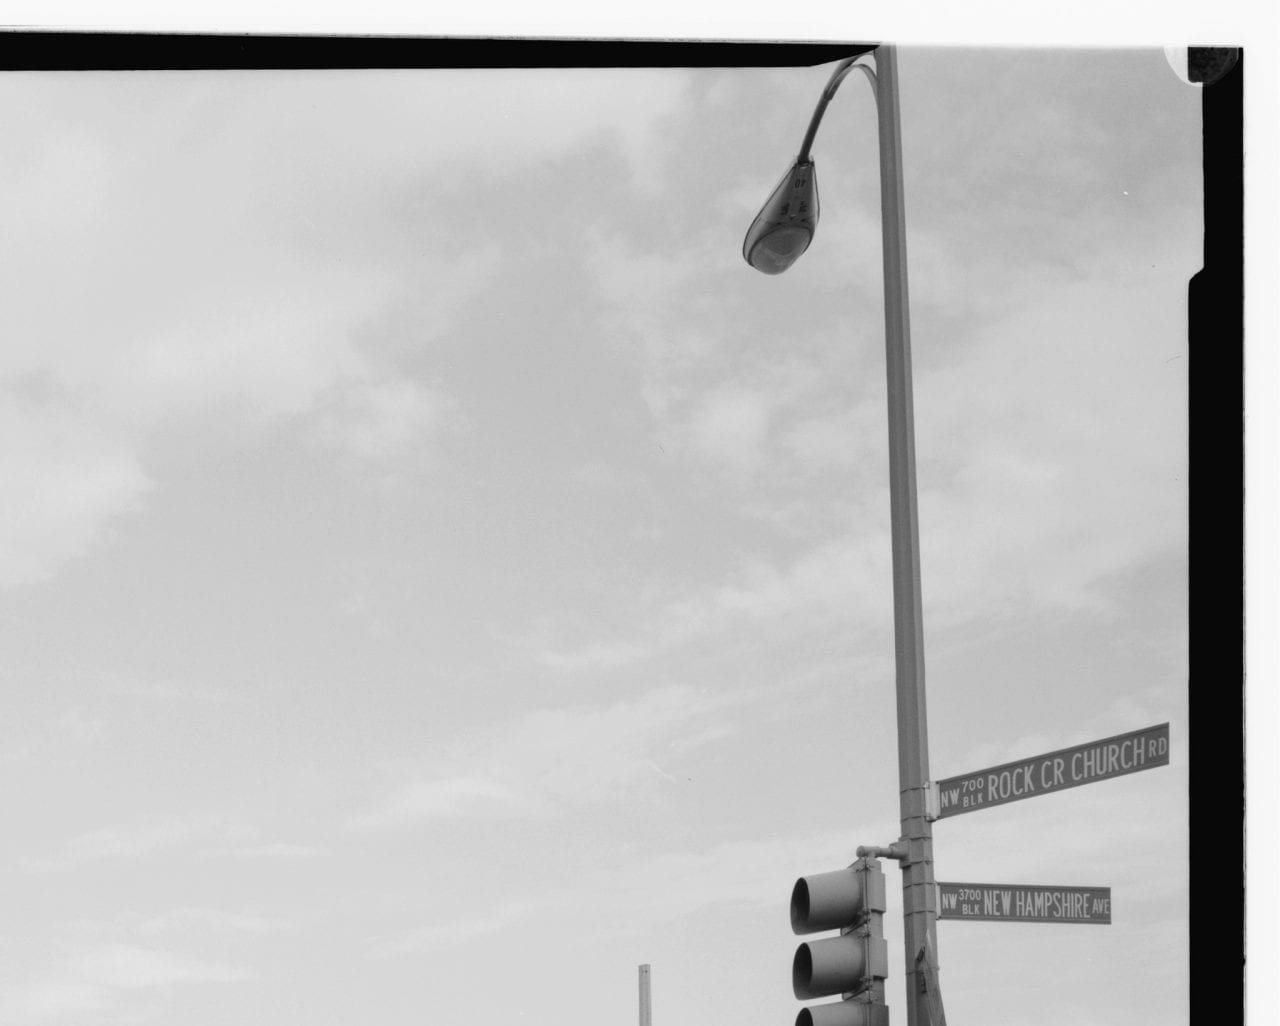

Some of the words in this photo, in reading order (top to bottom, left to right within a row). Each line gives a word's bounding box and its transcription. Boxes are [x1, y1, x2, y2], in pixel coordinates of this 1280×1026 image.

[1148, 737, 1167, 758] RD
[1071, 736, 1145, 781] CHURCH
[987, 764, 1036, 802] ROCK
[1041, 758, 1065, 789] CR
[961, 777, 984, 793] 700
[941, 788, 960, 808] NW
[962, 793, 983, 808] BLK
[942, 893, 958, 910] NW
[958, 889, 982, 901] 3700
[983, 890, 1012, 916] NEW
[1015, 891, 1091, 919] HAMPSHIRE
[962, 904, 980, 915] BLK
[1091, 898, 1110, 914] AVE
